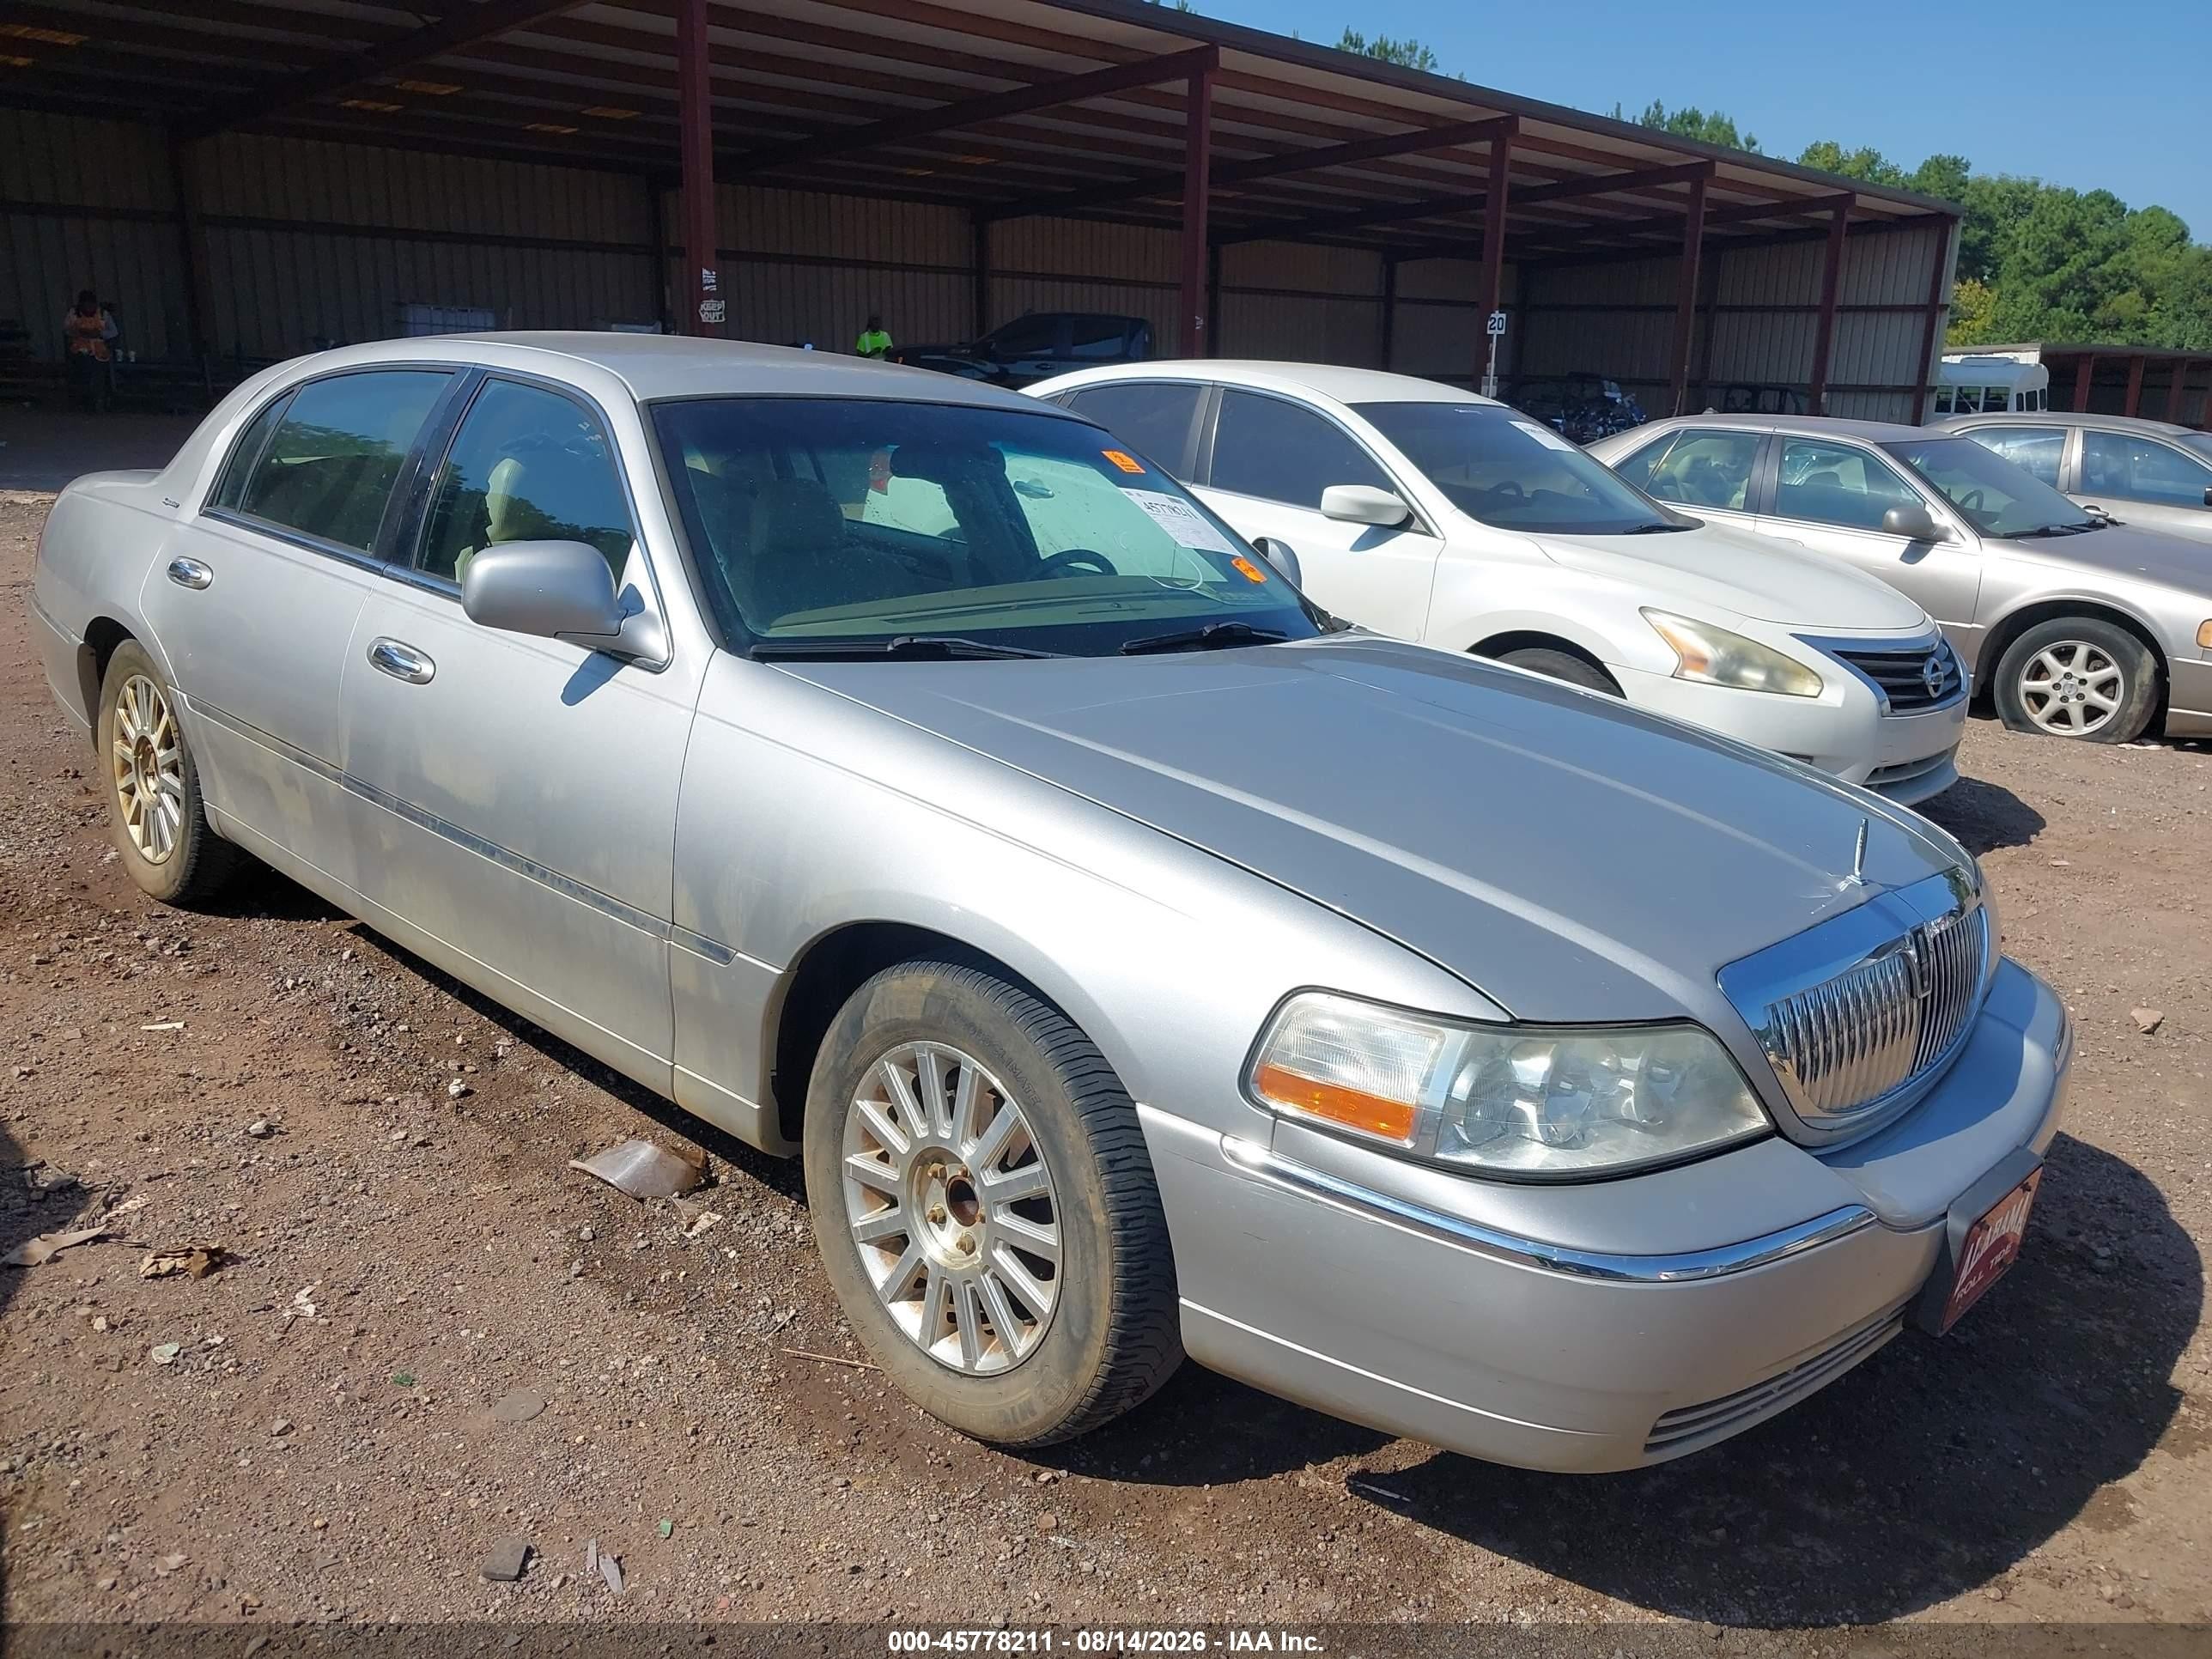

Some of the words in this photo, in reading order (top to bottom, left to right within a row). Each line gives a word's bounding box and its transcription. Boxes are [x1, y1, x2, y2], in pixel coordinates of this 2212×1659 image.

[703, 312, 723, 320] OUT
[1489, 317, 1504, 331] 20
[1143, 501, 1199, 520] 45778211
[1954, 1191, 2031, 1297] ALABAMA
[1955, 1270, 1984, 1304] ROLL
[1990, 1242, 2014, 1270] TIDE
